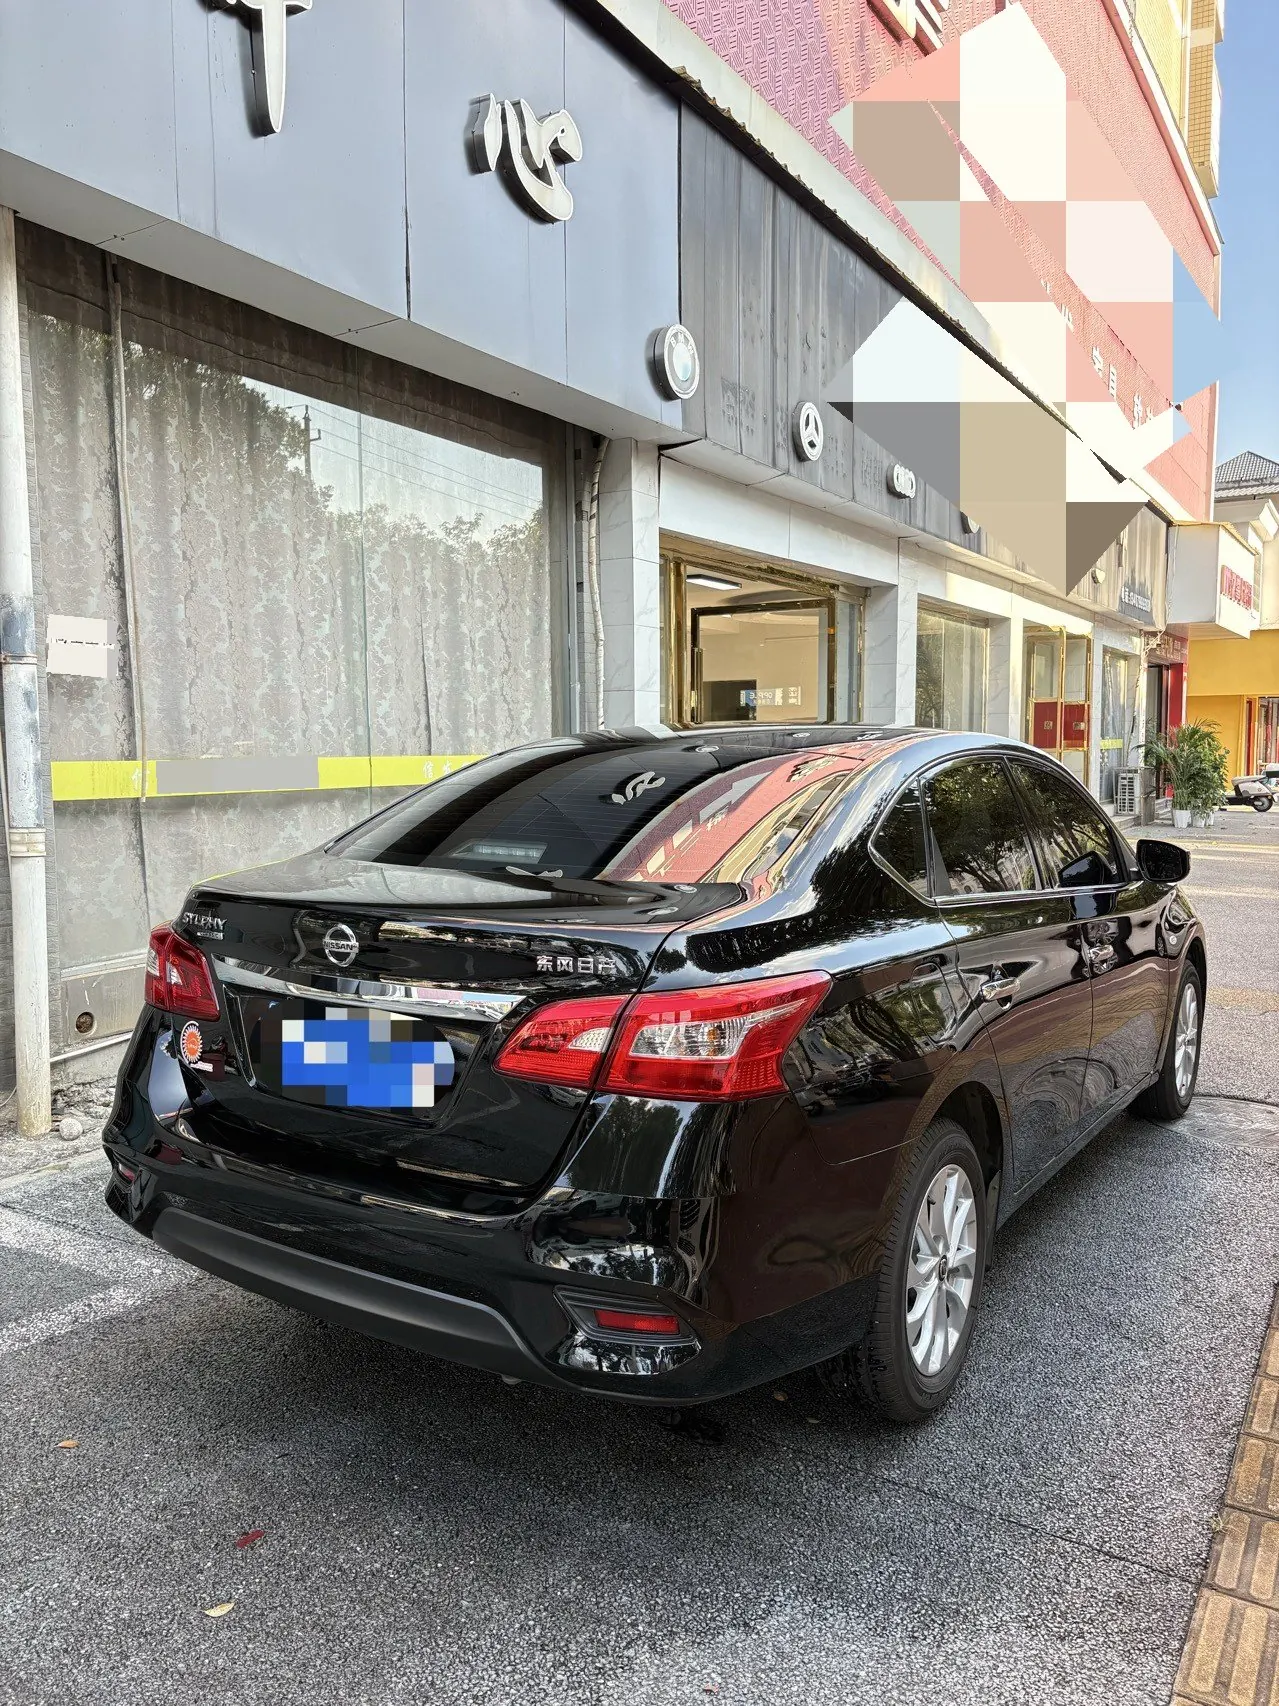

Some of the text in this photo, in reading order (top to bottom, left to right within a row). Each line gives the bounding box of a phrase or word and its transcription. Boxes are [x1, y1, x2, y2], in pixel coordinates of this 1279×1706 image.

[323, 939, 355, 951] NISSAN
[536, 955, 617, 975] 东风日产
